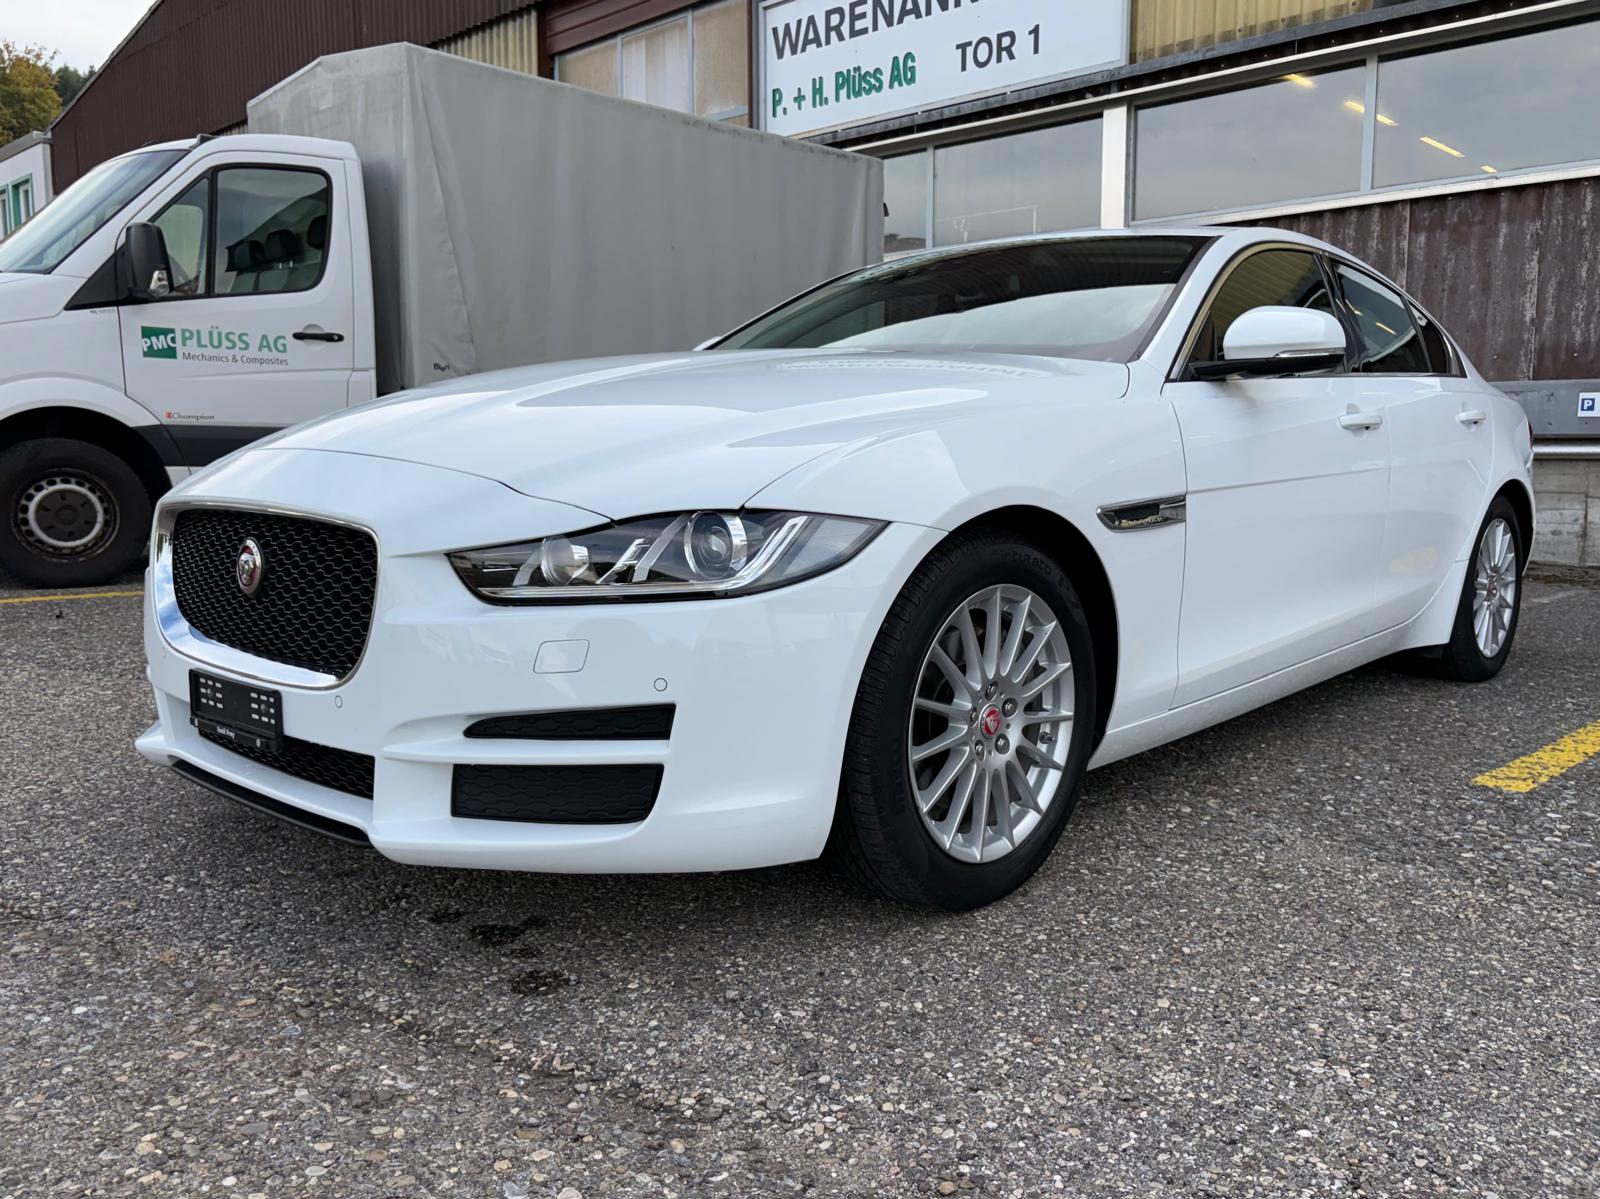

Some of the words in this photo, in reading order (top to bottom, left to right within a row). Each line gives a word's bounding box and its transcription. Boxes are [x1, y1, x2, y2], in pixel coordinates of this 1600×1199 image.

[773, 0, 981, 60] WARENA
[956, 31, 1016, 72] TOR
[1028, 24, 1040, 55] 1
[772, 88, 788, 118] P.
[812, 76, 829, 108] H.
[835, 65, 884, 101] Plüss
[889, 52, 916, 89] AG
[142, 333, 176, 352] PMC
[181, 325, 250, 351] PLÜSS
[258, 334, 287, 353] AG
[182, 352, 230, 363] Mechanics
[231, 354, 239, 364] &
[240, 355, 289, 367] Composites
